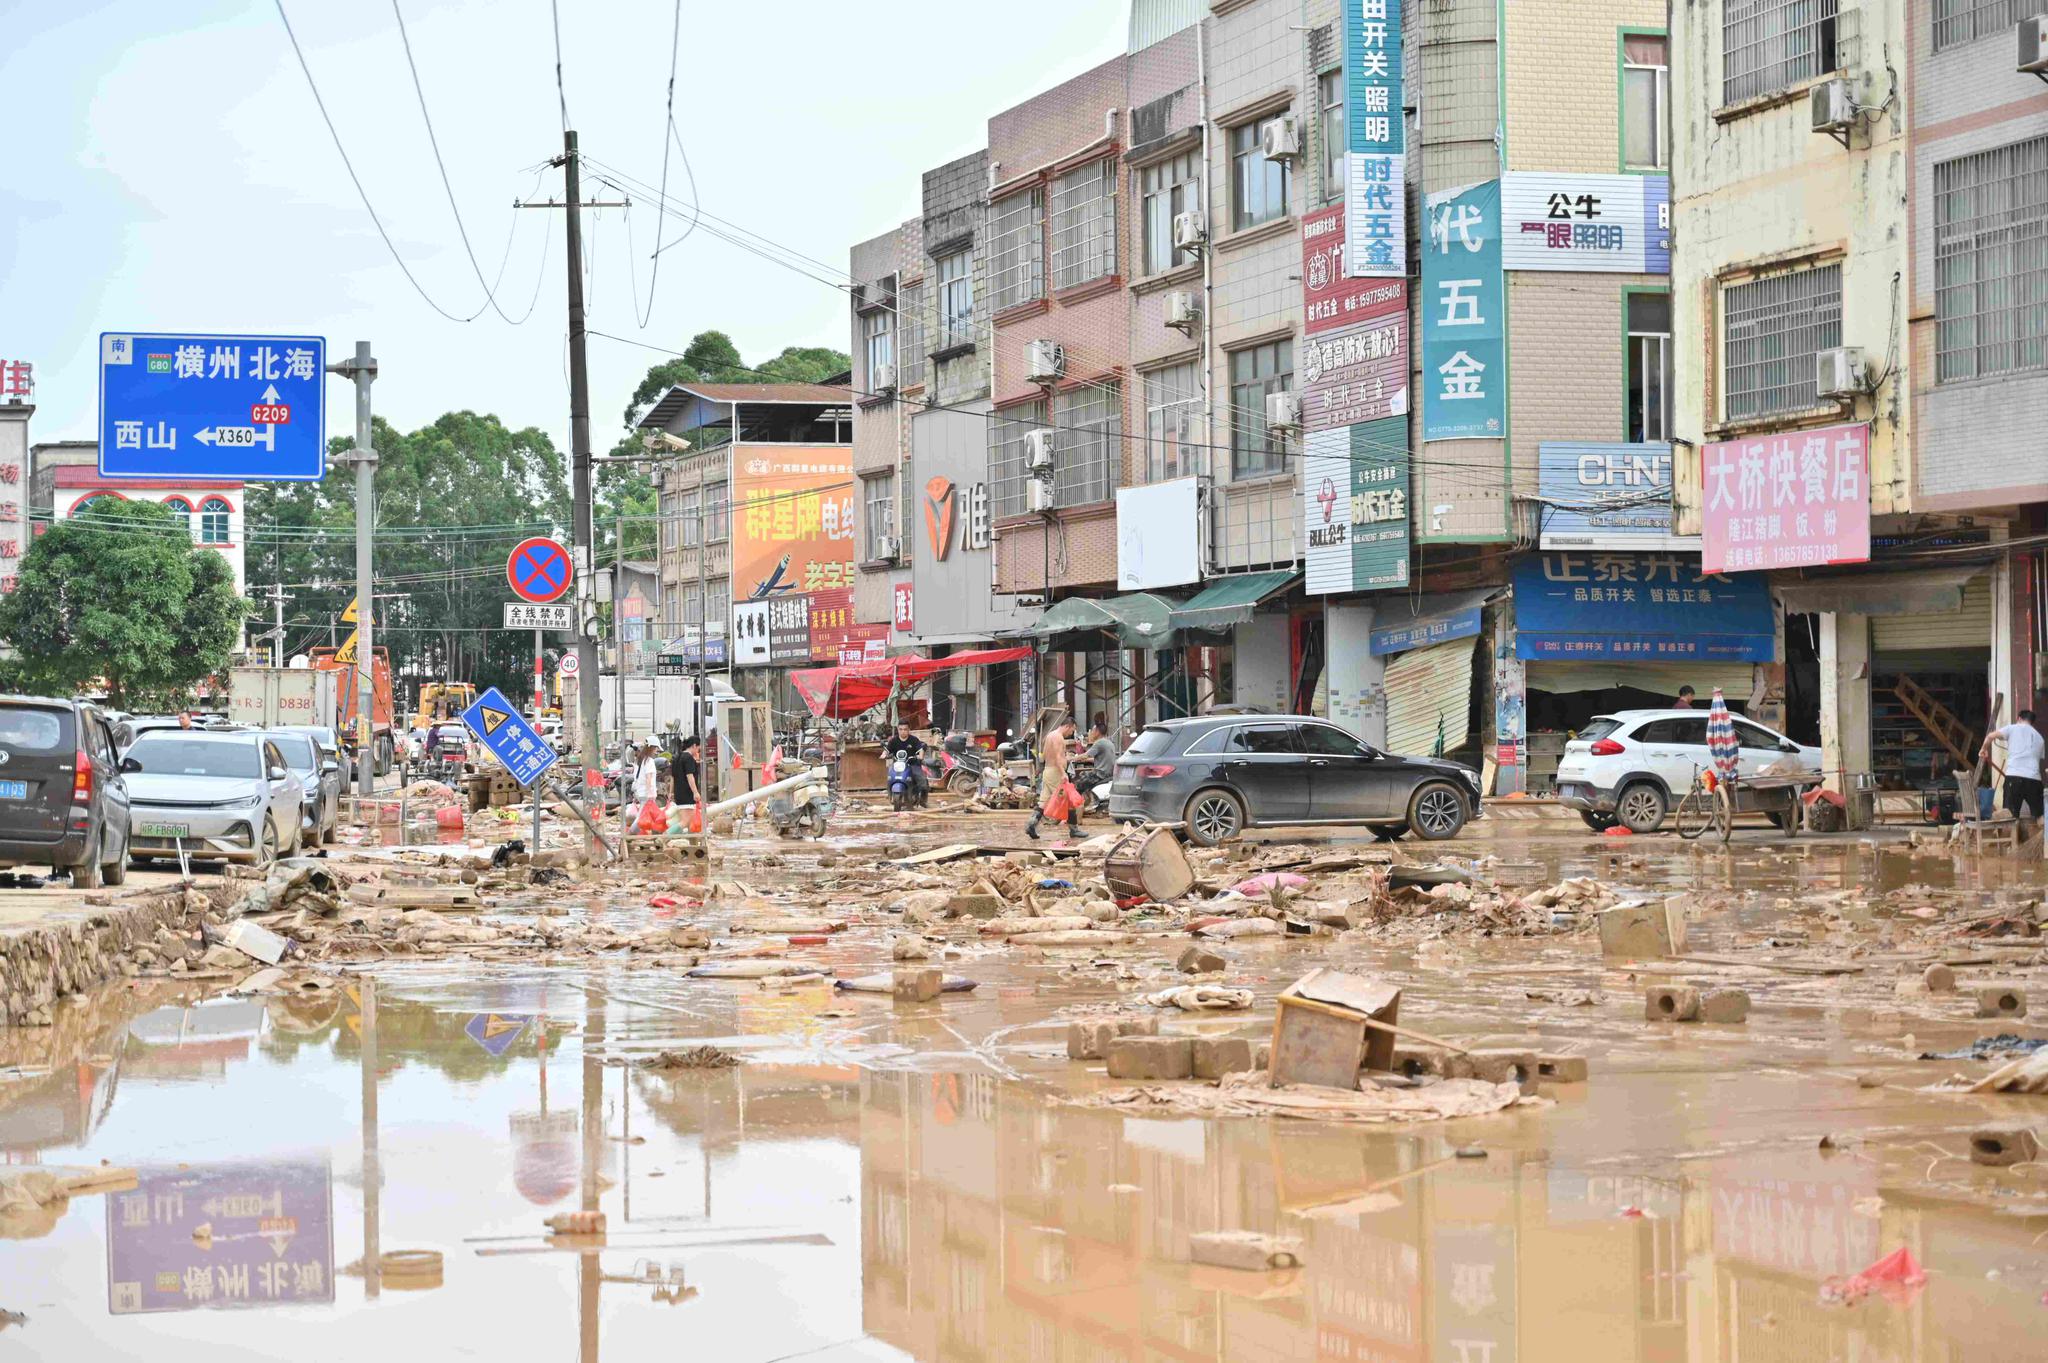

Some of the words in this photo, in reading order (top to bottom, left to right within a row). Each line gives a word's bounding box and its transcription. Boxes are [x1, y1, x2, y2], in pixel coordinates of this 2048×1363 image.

[1363, 156, 1394, 265] 时代五金
[1547, 193, 1602, 219] 公牛
[111, 338, 125, 353] 南
[150, 361, 168, 371] G80
[174, 344, 240, 380] 横州
[249, 346, 315, 381] 北海
[252, 406, 288, 422] G209
[114, 420, 176, 450] 西山
[218, 429, 253, 443] X360
[1709, 431, 1861, 513] 大桥快餐店
[958, 482, 988, 552] 雅
[1575, 588, 1636, 602] 品质开关
[1650, 588, 1713, 603] 智选正泰
[511, 606, 566, 620] 全线禁停
[563, 659, 576, 669] 40
[497, 724, 522, 747] 一停
[515, 746, 552, 780] 三通过
